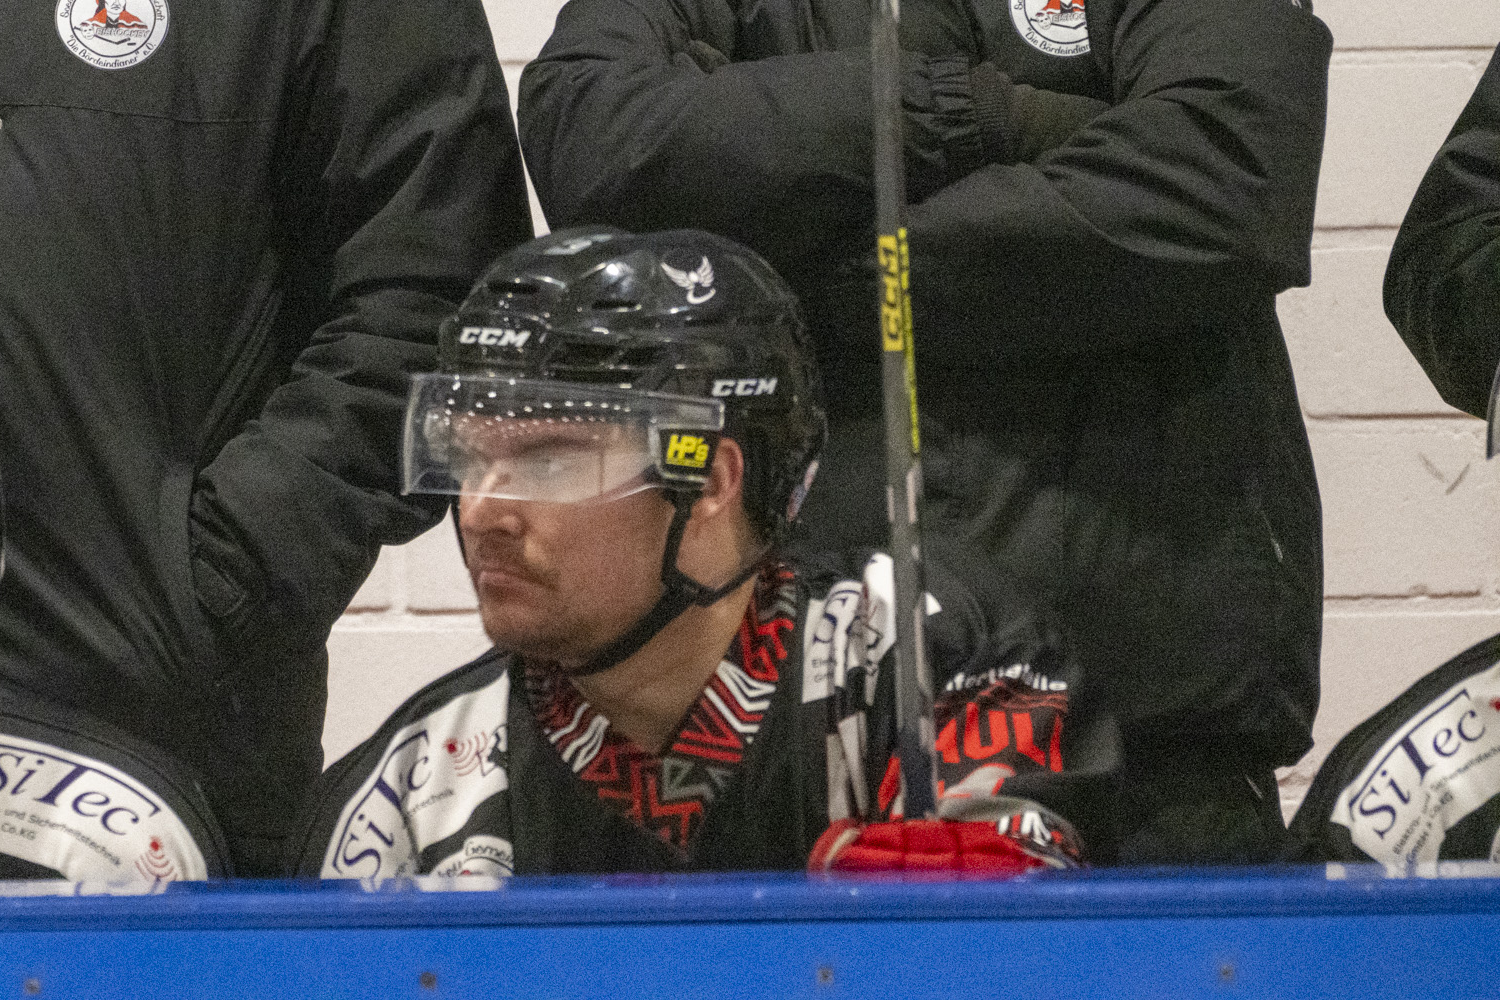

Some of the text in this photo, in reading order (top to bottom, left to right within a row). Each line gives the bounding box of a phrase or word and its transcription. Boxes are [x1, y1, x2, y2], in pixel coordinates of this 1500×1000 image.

[459, 327, 531, 347] CCM
[712, 377, 778, 397] CCM
[333, 729, 431, 882] SiTc
[1348, 688, 1486, 840] SiTec
